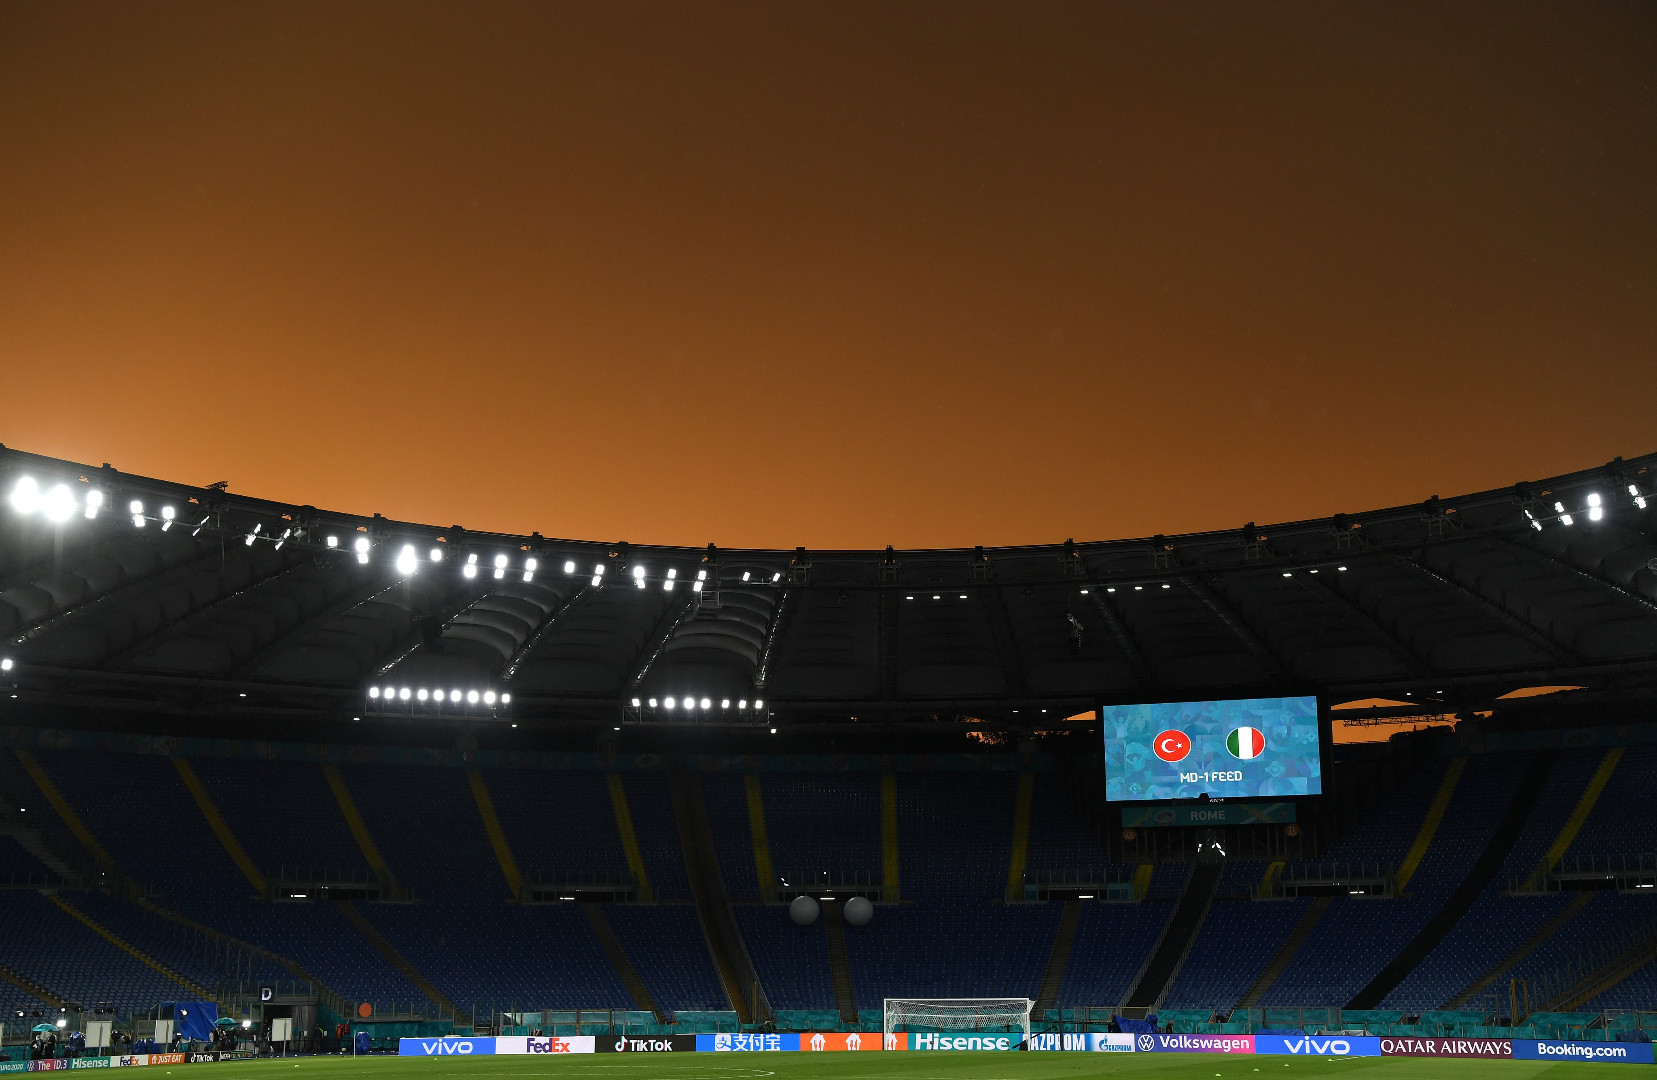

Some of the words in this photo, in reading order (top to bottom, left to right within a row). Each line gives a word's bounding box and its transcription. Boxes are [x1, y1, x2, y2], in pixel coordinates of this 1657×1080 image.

[1180, 772, 1209, 783] MD-1
[1212, 771, 1243, 782] FEED
[1190, 811, 1225, 820] ROME
[261, 988, 272, 1001] D
[422, 1039, 474, 1054] vivo
[527, 1038, 571, 1053] FedEx
[630, 1039, 673, 1052] TikTok
[733, 1034, 781, 1052] 支付宝
[915, 1033, 1010, 1050] Hisense
[1159, 1035, 1250, 1053] Volkswagen
[1284, 1036, 1351, 1054] vivo
[1380, 1039, 1437, 1054] QATAR
[1440, 1040, 1512, 1055] AIRWAYS
[1537, 1043, 1627, 1058] Booking.com
[71, 1059, 108, 1069] Hisense
[120, 1057, 140, 1067] FedEx
[157, 1055, 171, 1064] JUST
[171, 1054, 183, 1062] EAT
[196, 1054, 214, 1062] TikTok
[37, 1061, 51, 1071] The
[53, 1060, 68, 1070] ID.3
